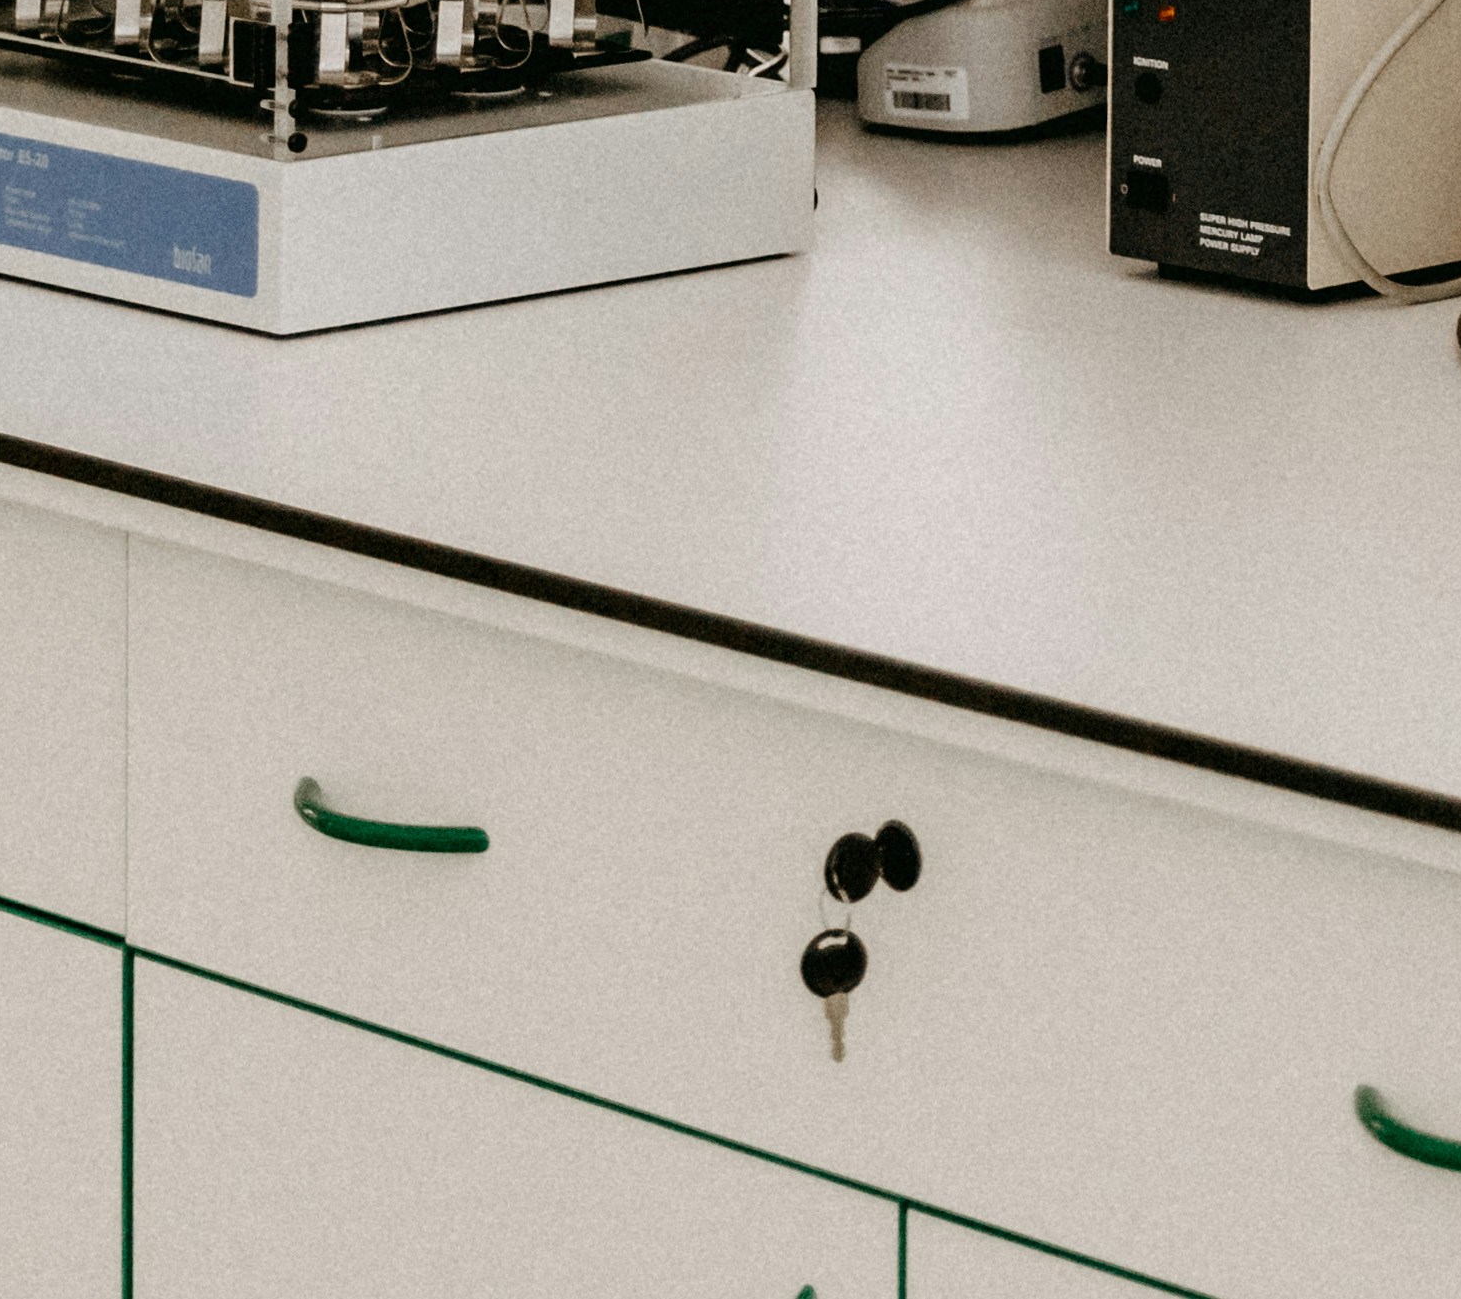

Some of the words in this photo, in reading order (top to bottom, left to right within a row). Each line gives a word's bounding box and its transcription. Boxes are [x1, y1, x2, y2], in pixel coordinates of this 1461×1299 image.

[1133, 55, 1169, 70] IGNITION
[1133, 154, 1162, 168] POWER
[1199, 211, 1227, 225] SUPER
[1227, 216, 1248, 229] HIGH
[1250, 221, 1291, 237] PRESSURE
[1199, 224, 1239, 239] MERCURY
[1240, 231, 1264, 244] LAMP
[1199, 237, 1229, 252] POWER
[1230, 242, 1261, 256] SUPPLY
